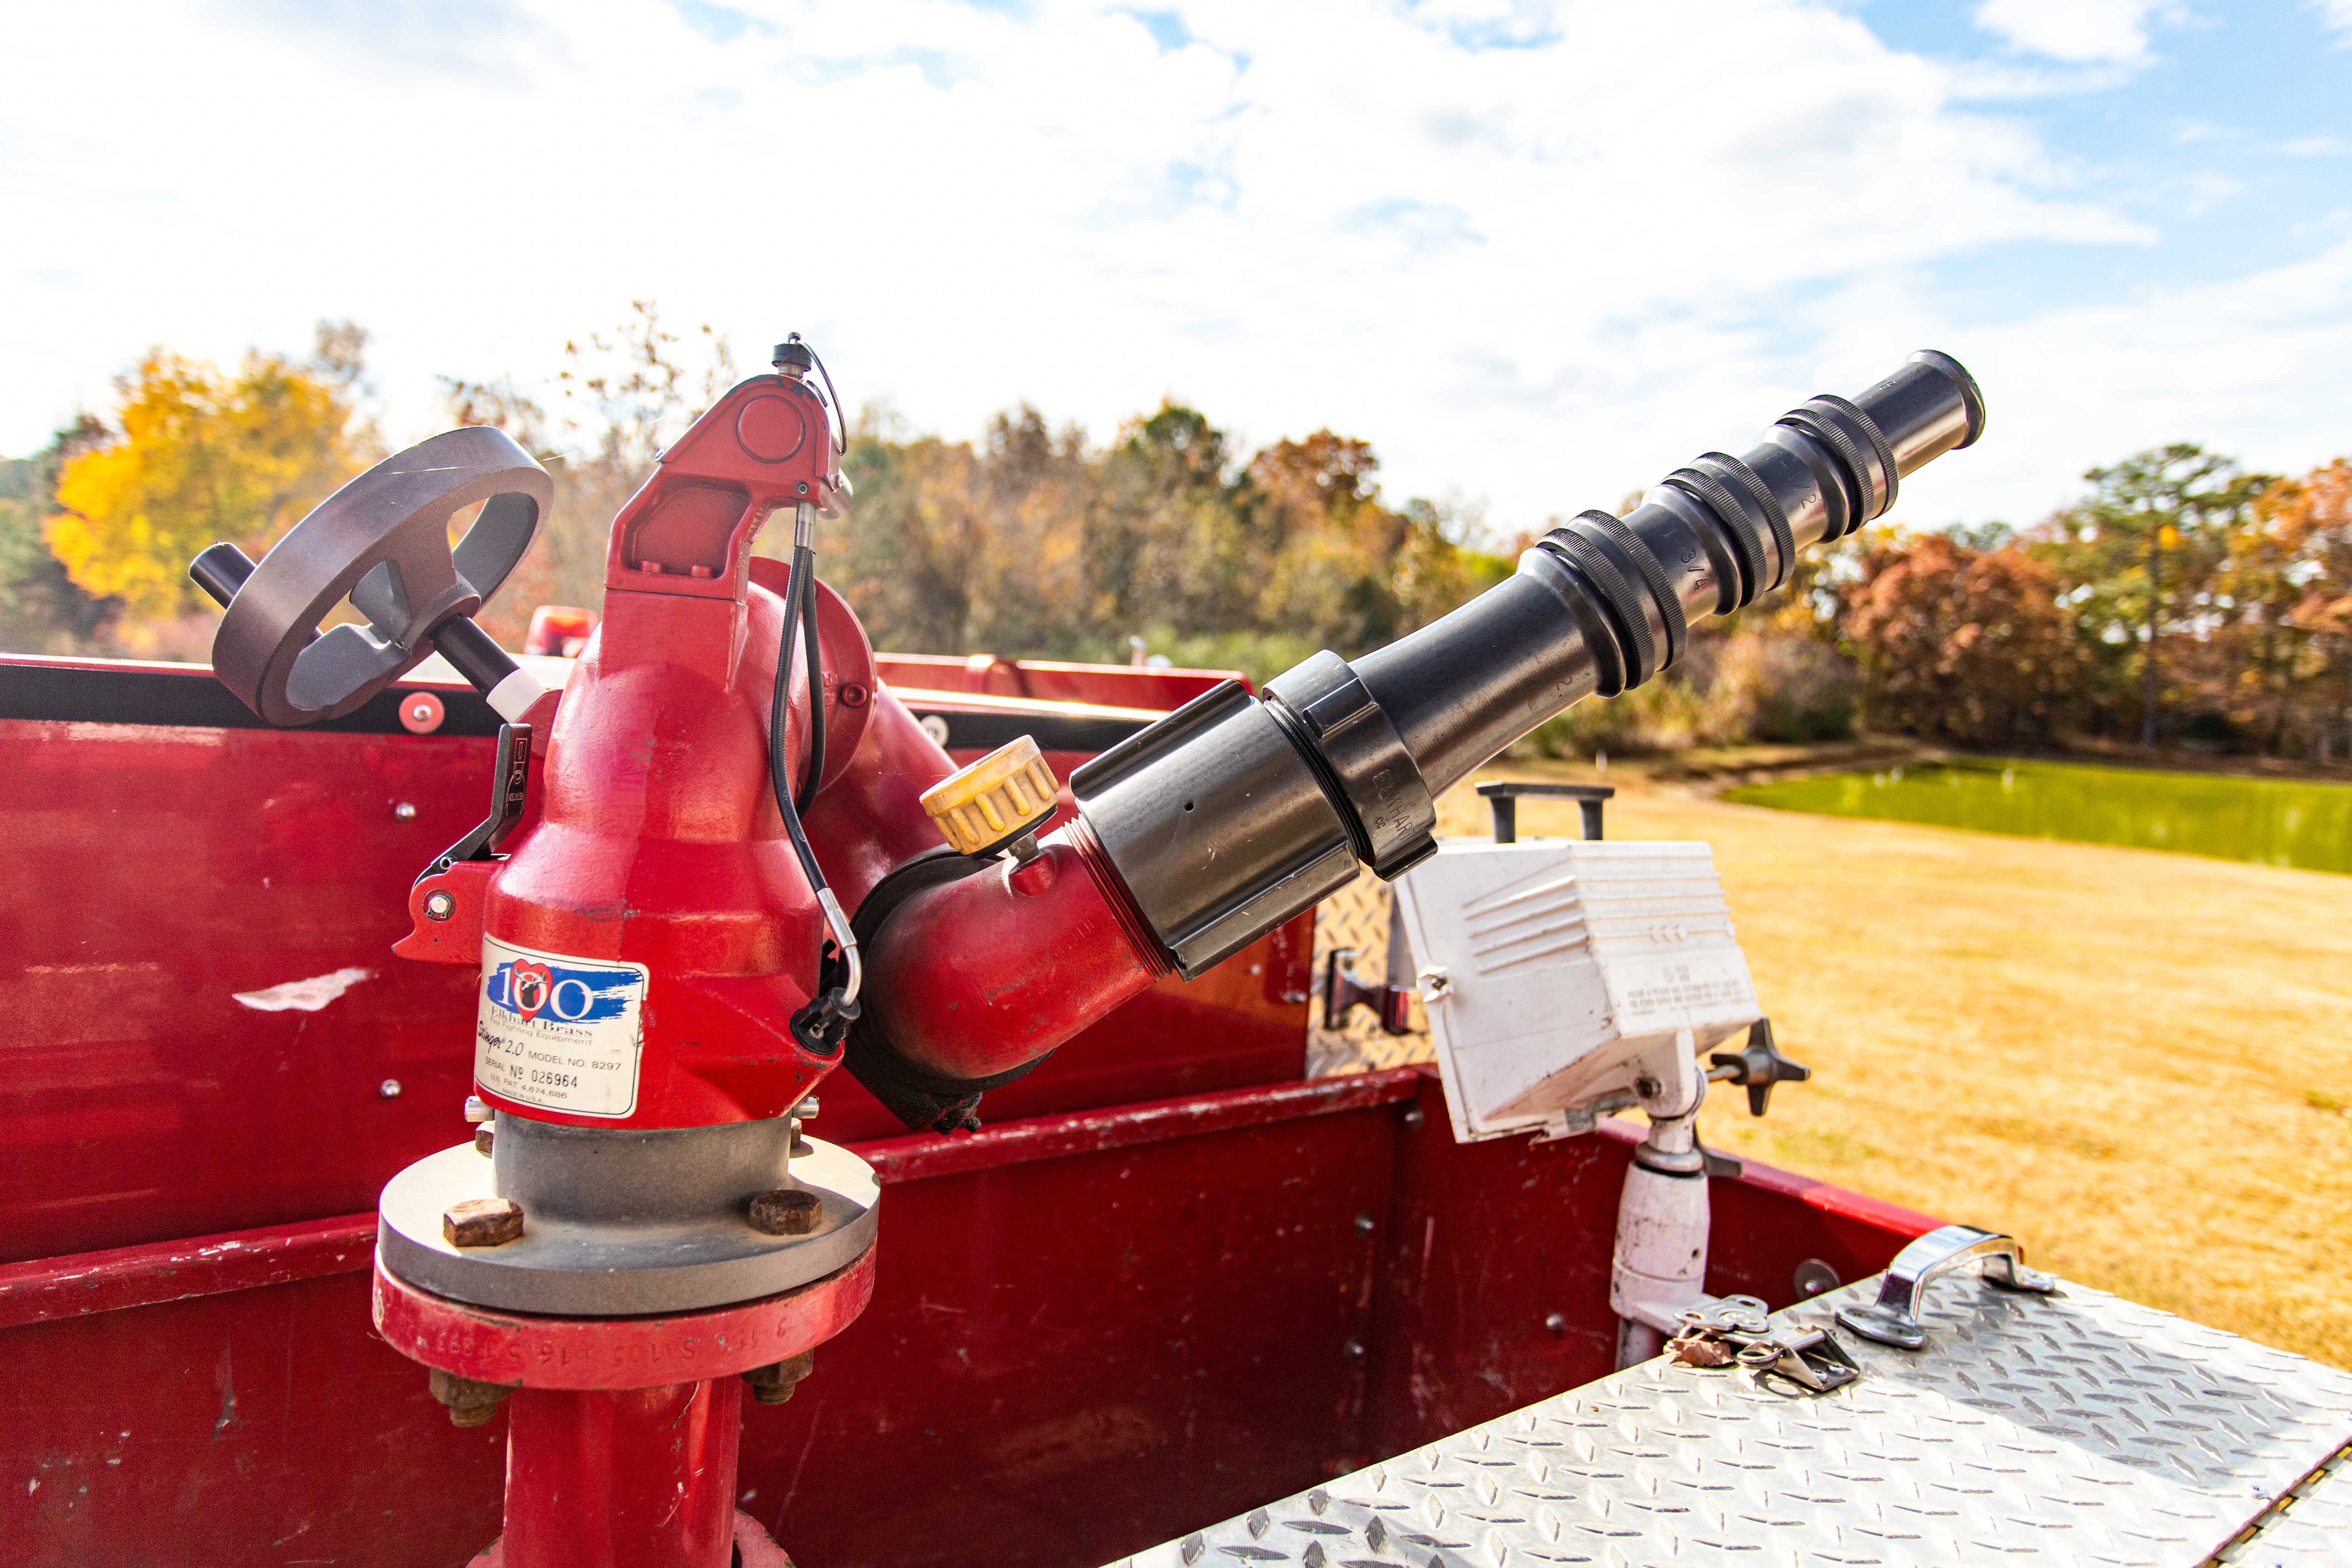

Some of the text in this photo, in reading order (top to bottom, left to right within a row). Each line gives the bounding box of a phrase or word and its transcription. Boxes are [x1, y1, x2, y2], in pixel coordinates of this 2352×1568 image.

[1372, 769, 1415, 841] ELKHART
[497, 967, 594, 1020] 100
[490, 1017, 593, 1046] Fire Fighting Equipment
[491, 1006, 592, 1036] Elkhart Brass
[505, 1040, 524, 1056] 2.0
[528, 1051, 564, 1065] MODEL
[568, 1058, 587, 1068] NO.
[591, 1061, 621, 1070] 8297
[485, 1056, 505, 1072] SERIAL
[531, 1070, 577, 1089] 026964
[490, 1073, 501, 1083] U.S.
[504, 1079, 519, 1089] PAT.
[502, 1088, 518, 1096] MADE
